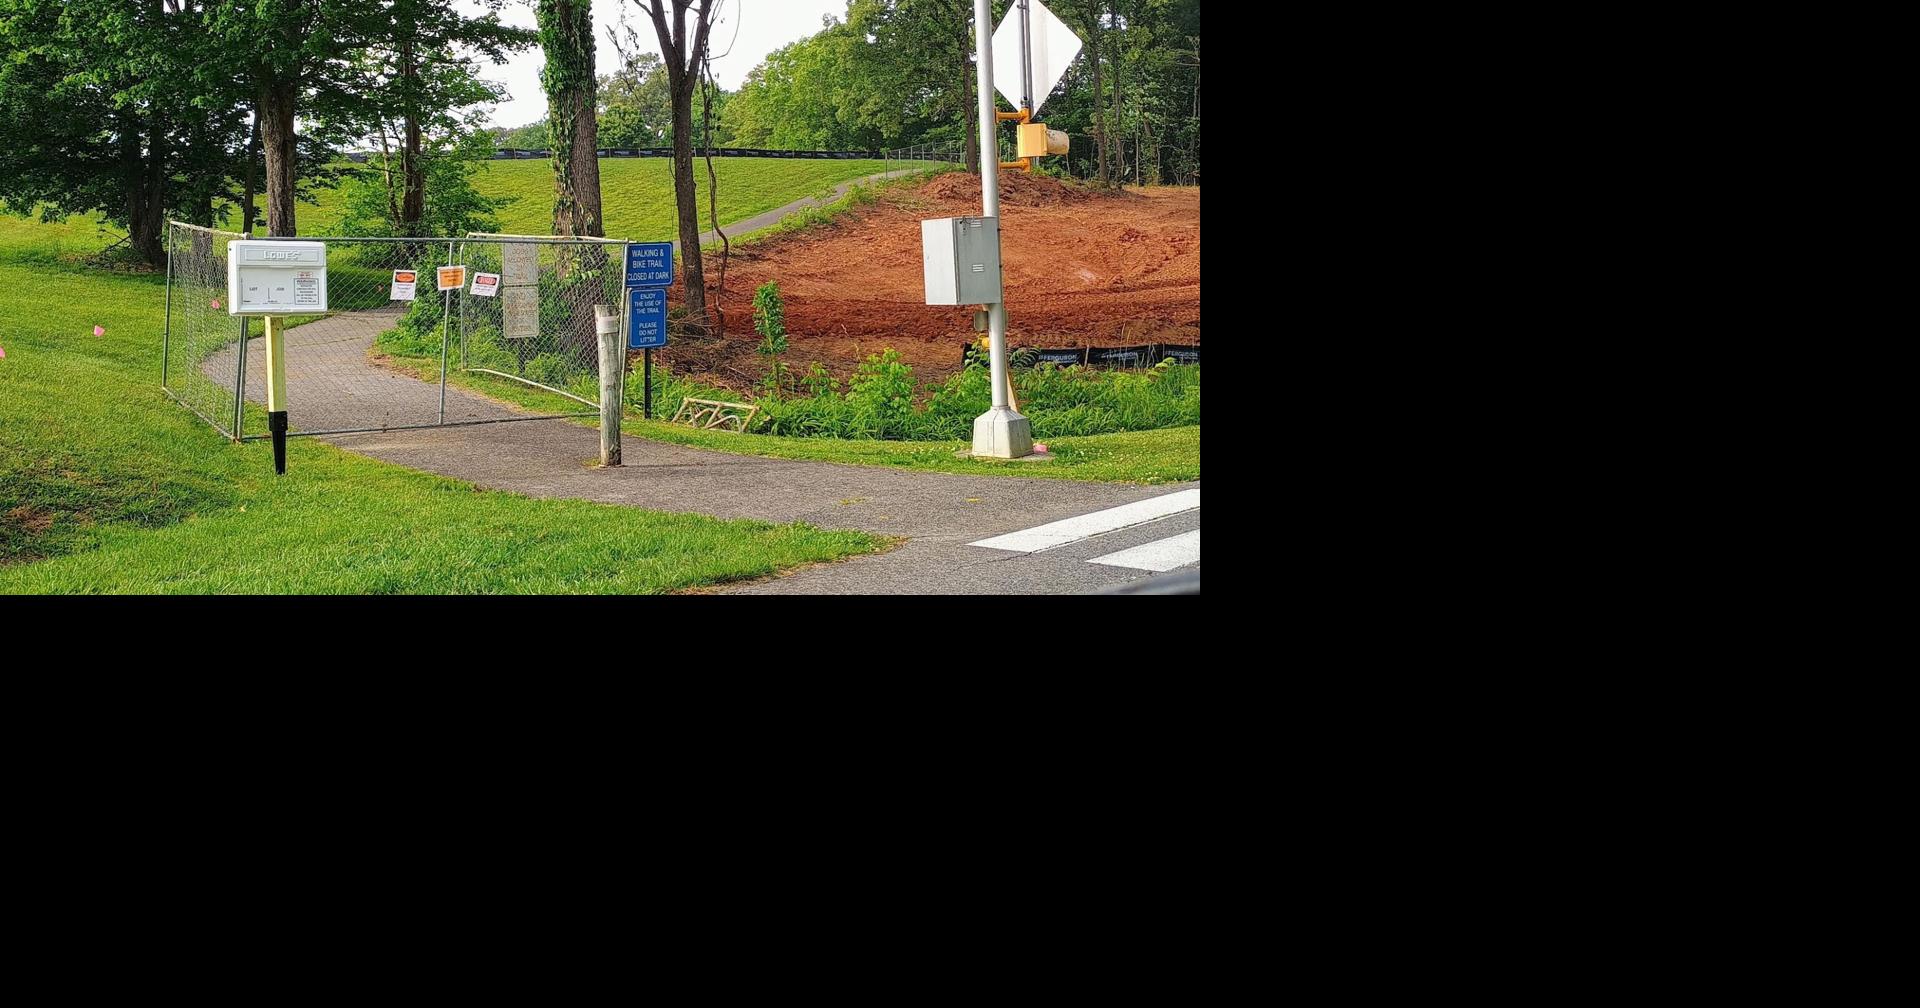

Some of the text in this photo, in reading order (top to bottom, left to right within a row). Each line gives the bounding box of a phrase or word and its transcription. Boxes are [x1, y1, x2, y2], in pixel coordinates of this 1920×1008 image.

[631, 249, 658, 257] WALKING
[633, 260, 646, 268] BIKE
[656, 272, 669, 280] DARK
